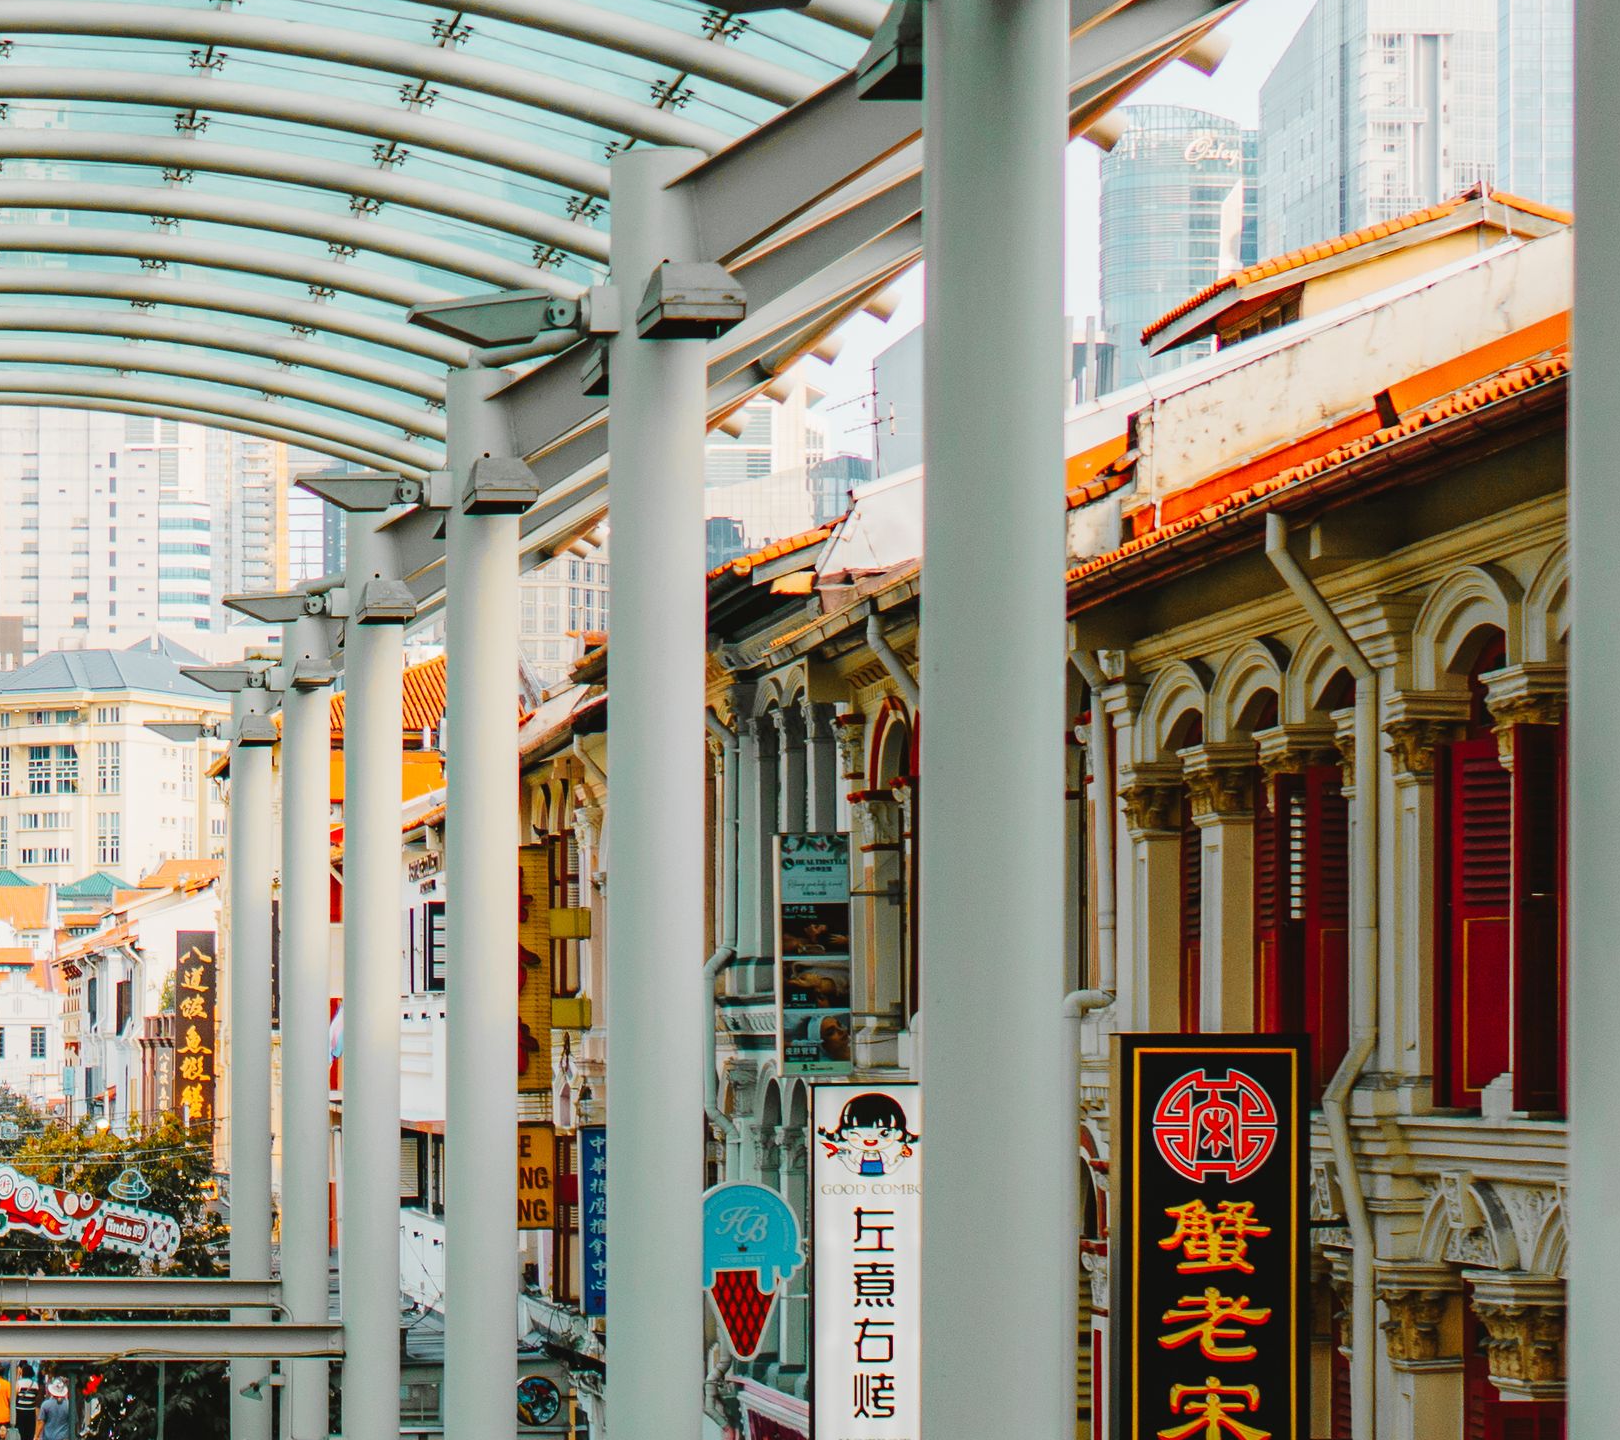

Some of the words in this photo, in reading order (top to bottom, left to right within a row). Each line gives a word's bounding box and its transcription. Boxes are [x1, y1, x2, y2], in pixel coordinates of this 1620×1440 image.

[821, 1184, 866, 1195] GOOD
[105, 1217, 132, 1237] finds
[853, 1207, 894, 1418] 左煮右烤
